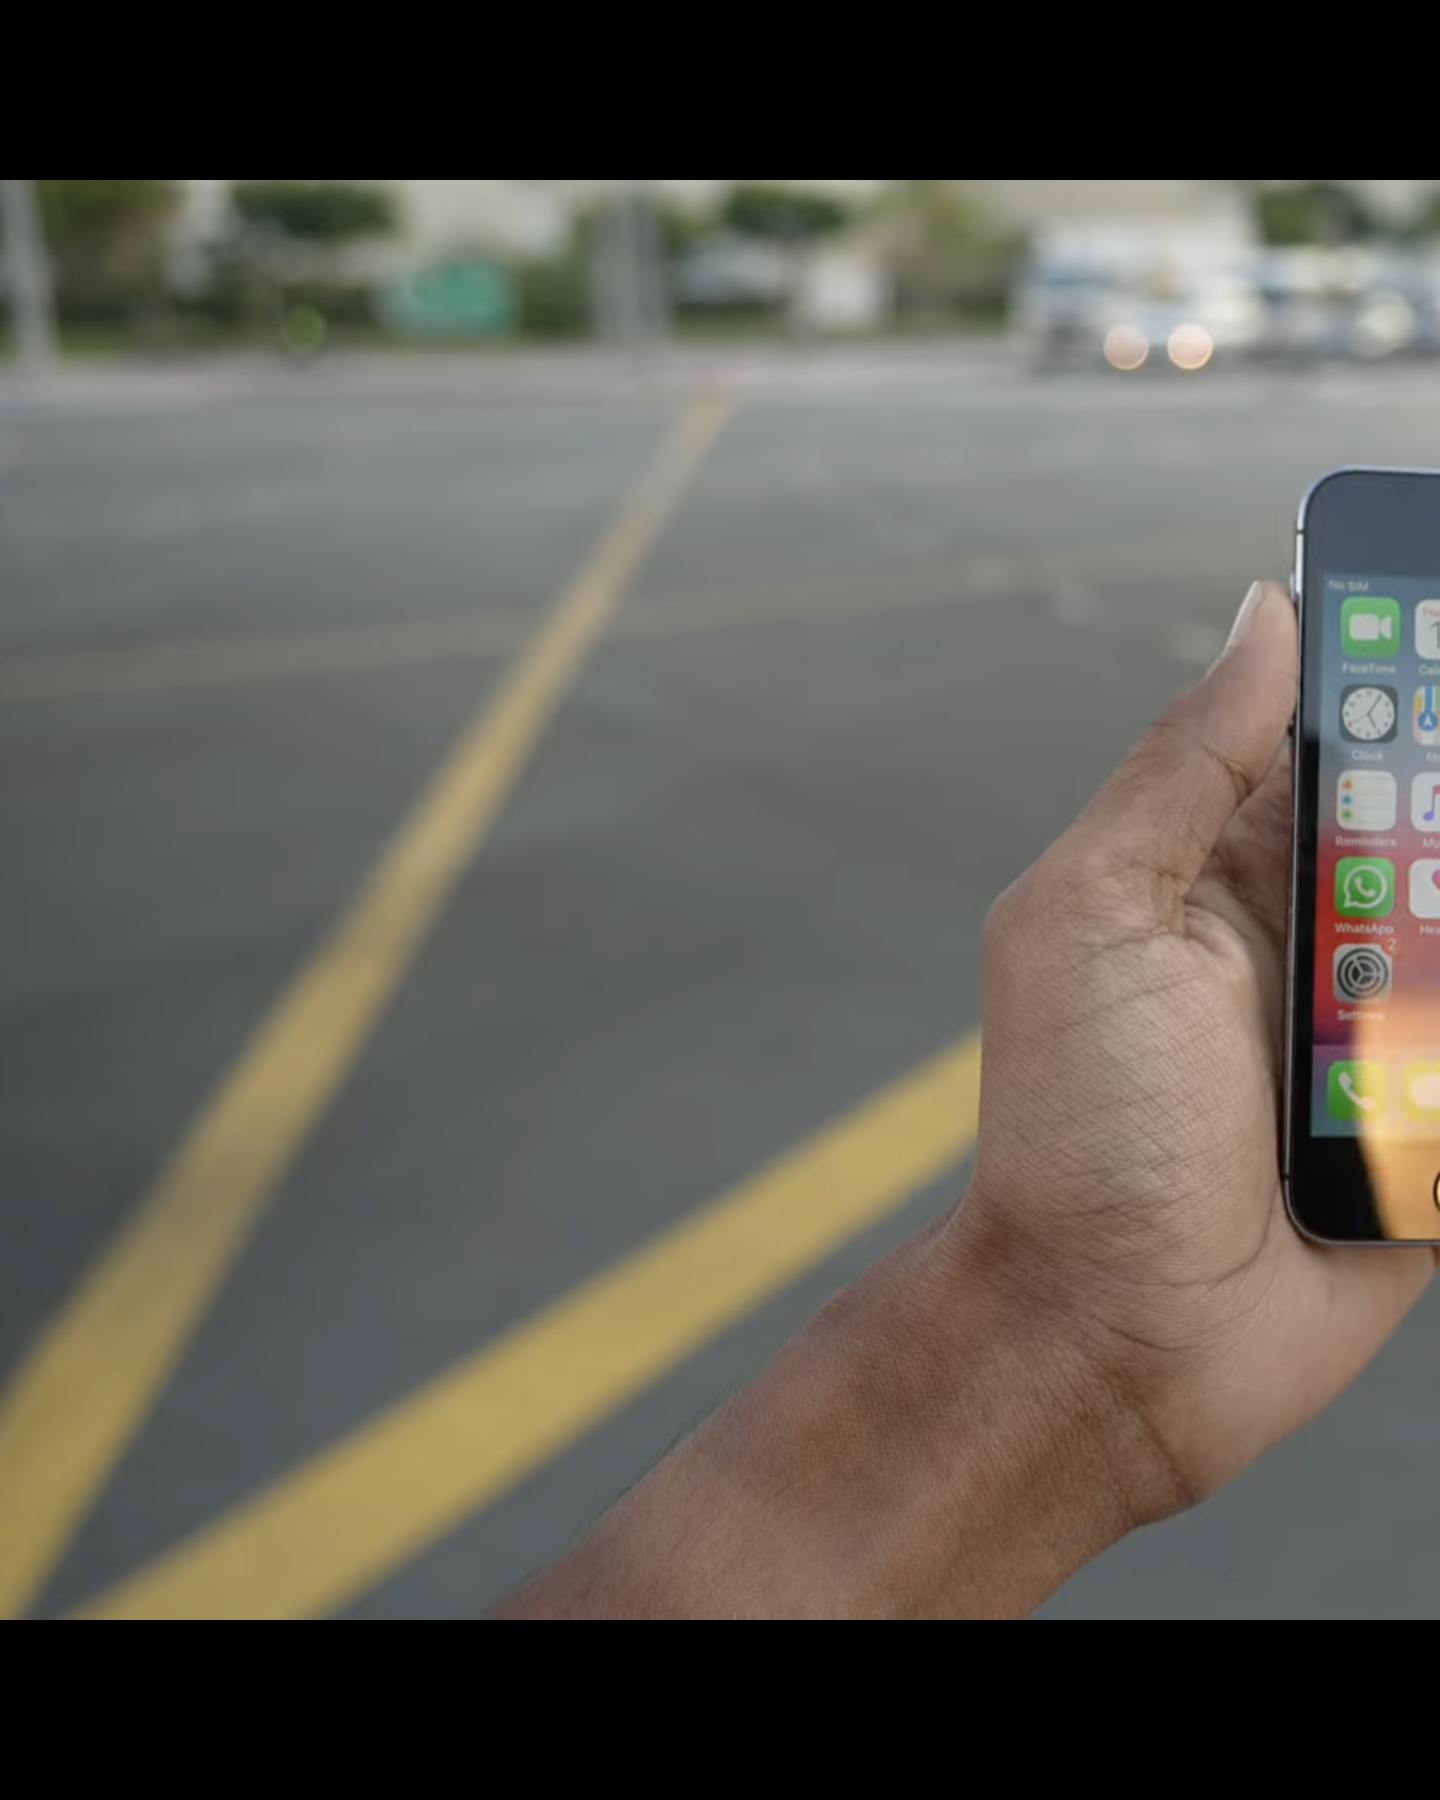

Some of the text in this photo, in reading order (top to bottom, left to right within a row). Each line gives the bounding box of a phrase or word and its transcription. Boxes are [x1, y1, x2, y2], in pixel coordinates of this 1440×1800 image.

[1329, 580, 1369, 592] No SIM
[1342, 664, 1396, 674] FaceTime
[1352, 751, 1384, 761] Clock
[1335, 836, 1397, 848] Reminders
[1335, 922, 1394, 936] WhatsApp
[1387, 938, 1397, 951] 2
